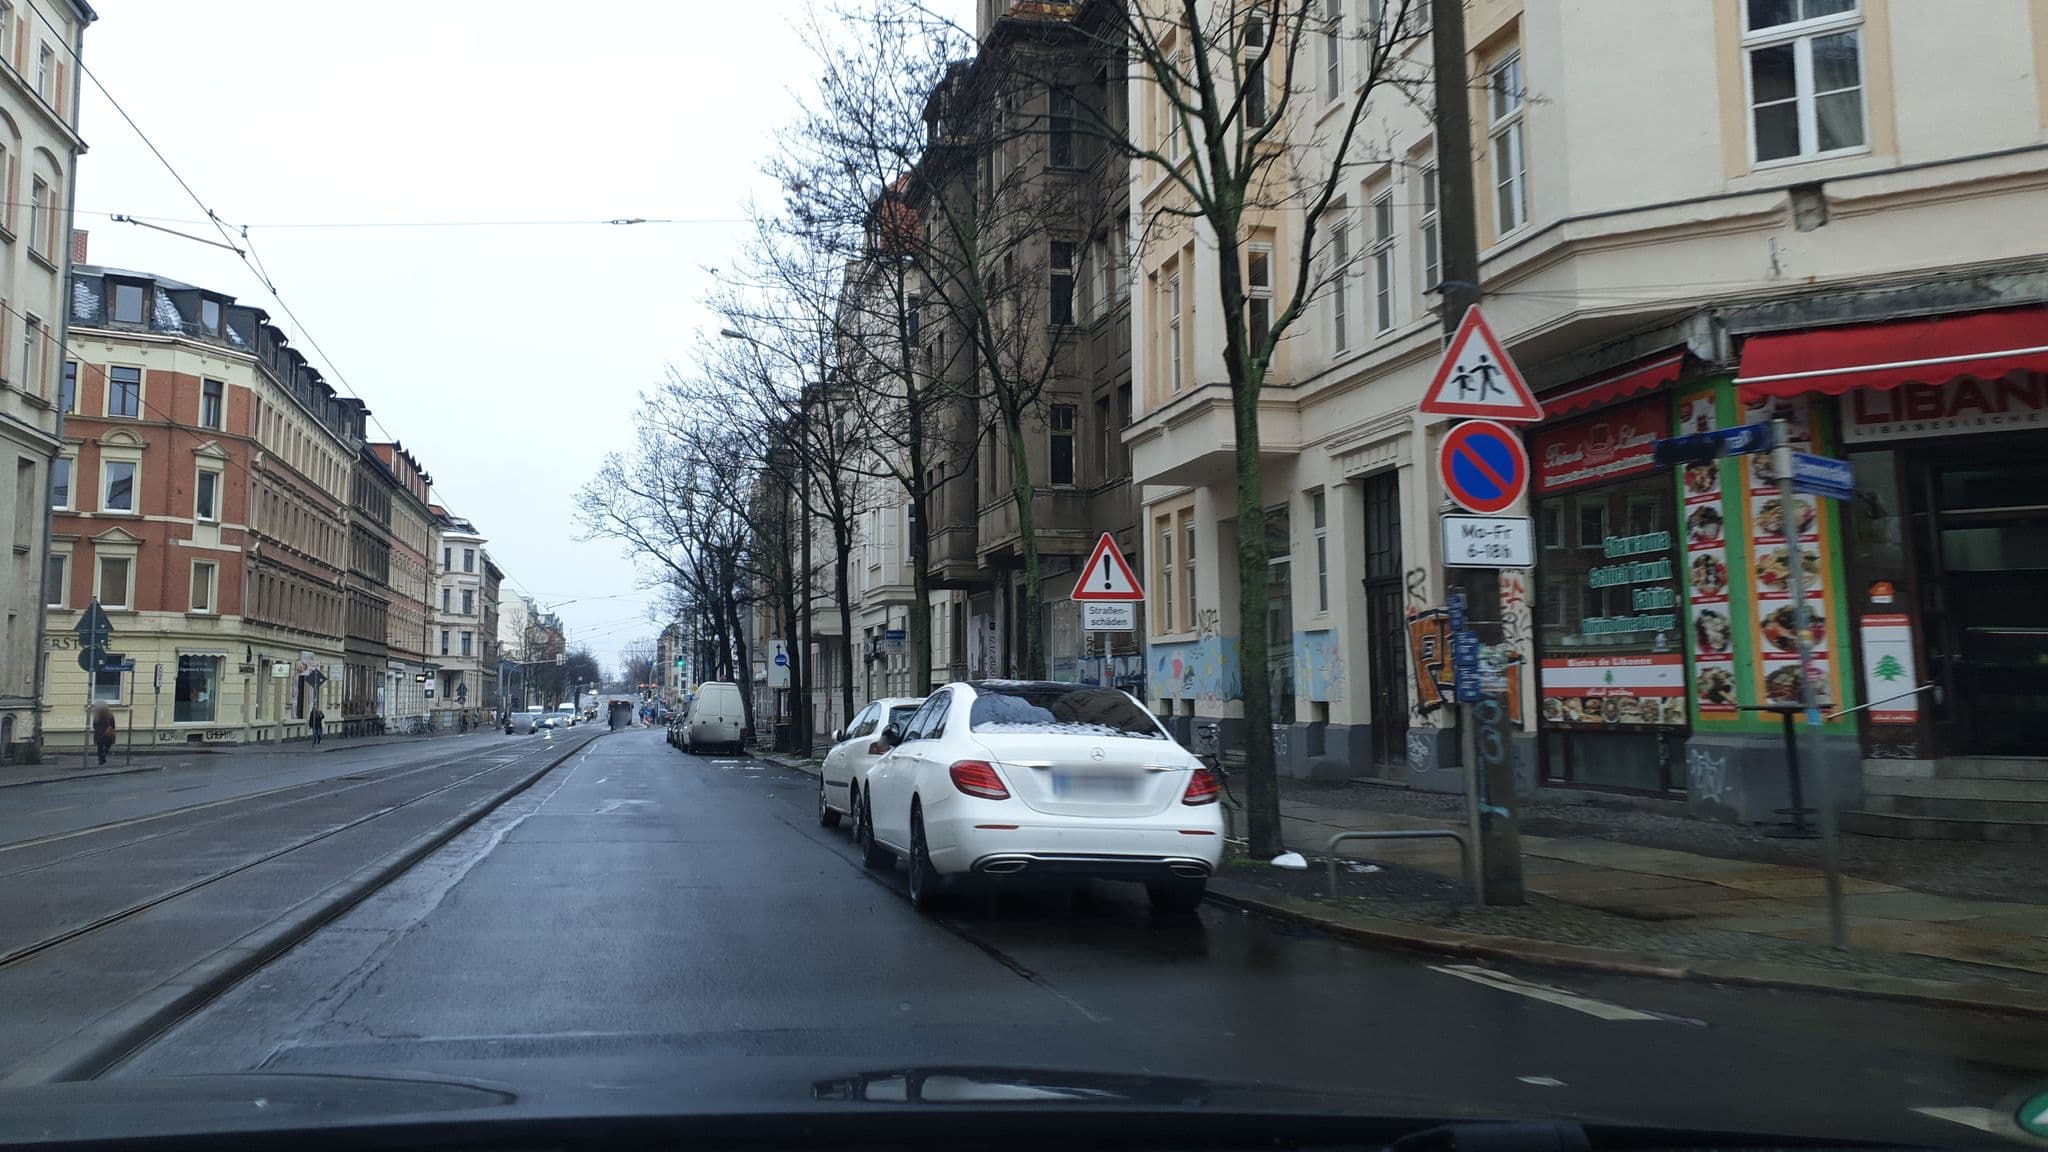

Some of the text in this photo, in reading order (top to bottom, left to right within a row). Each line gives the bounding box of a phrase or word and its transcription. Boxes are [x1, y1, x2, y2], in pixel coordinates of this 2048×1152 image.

[1854, 412, 2040, 436] LIBANESISCHE
[1461, 523, 1513, 540] Mo-Fr
[1466, 543, 1513, 559] 6-18h
[1089, 606, 1128, 615] Straßen-
[1090, 617, 1128, 626] schäden
